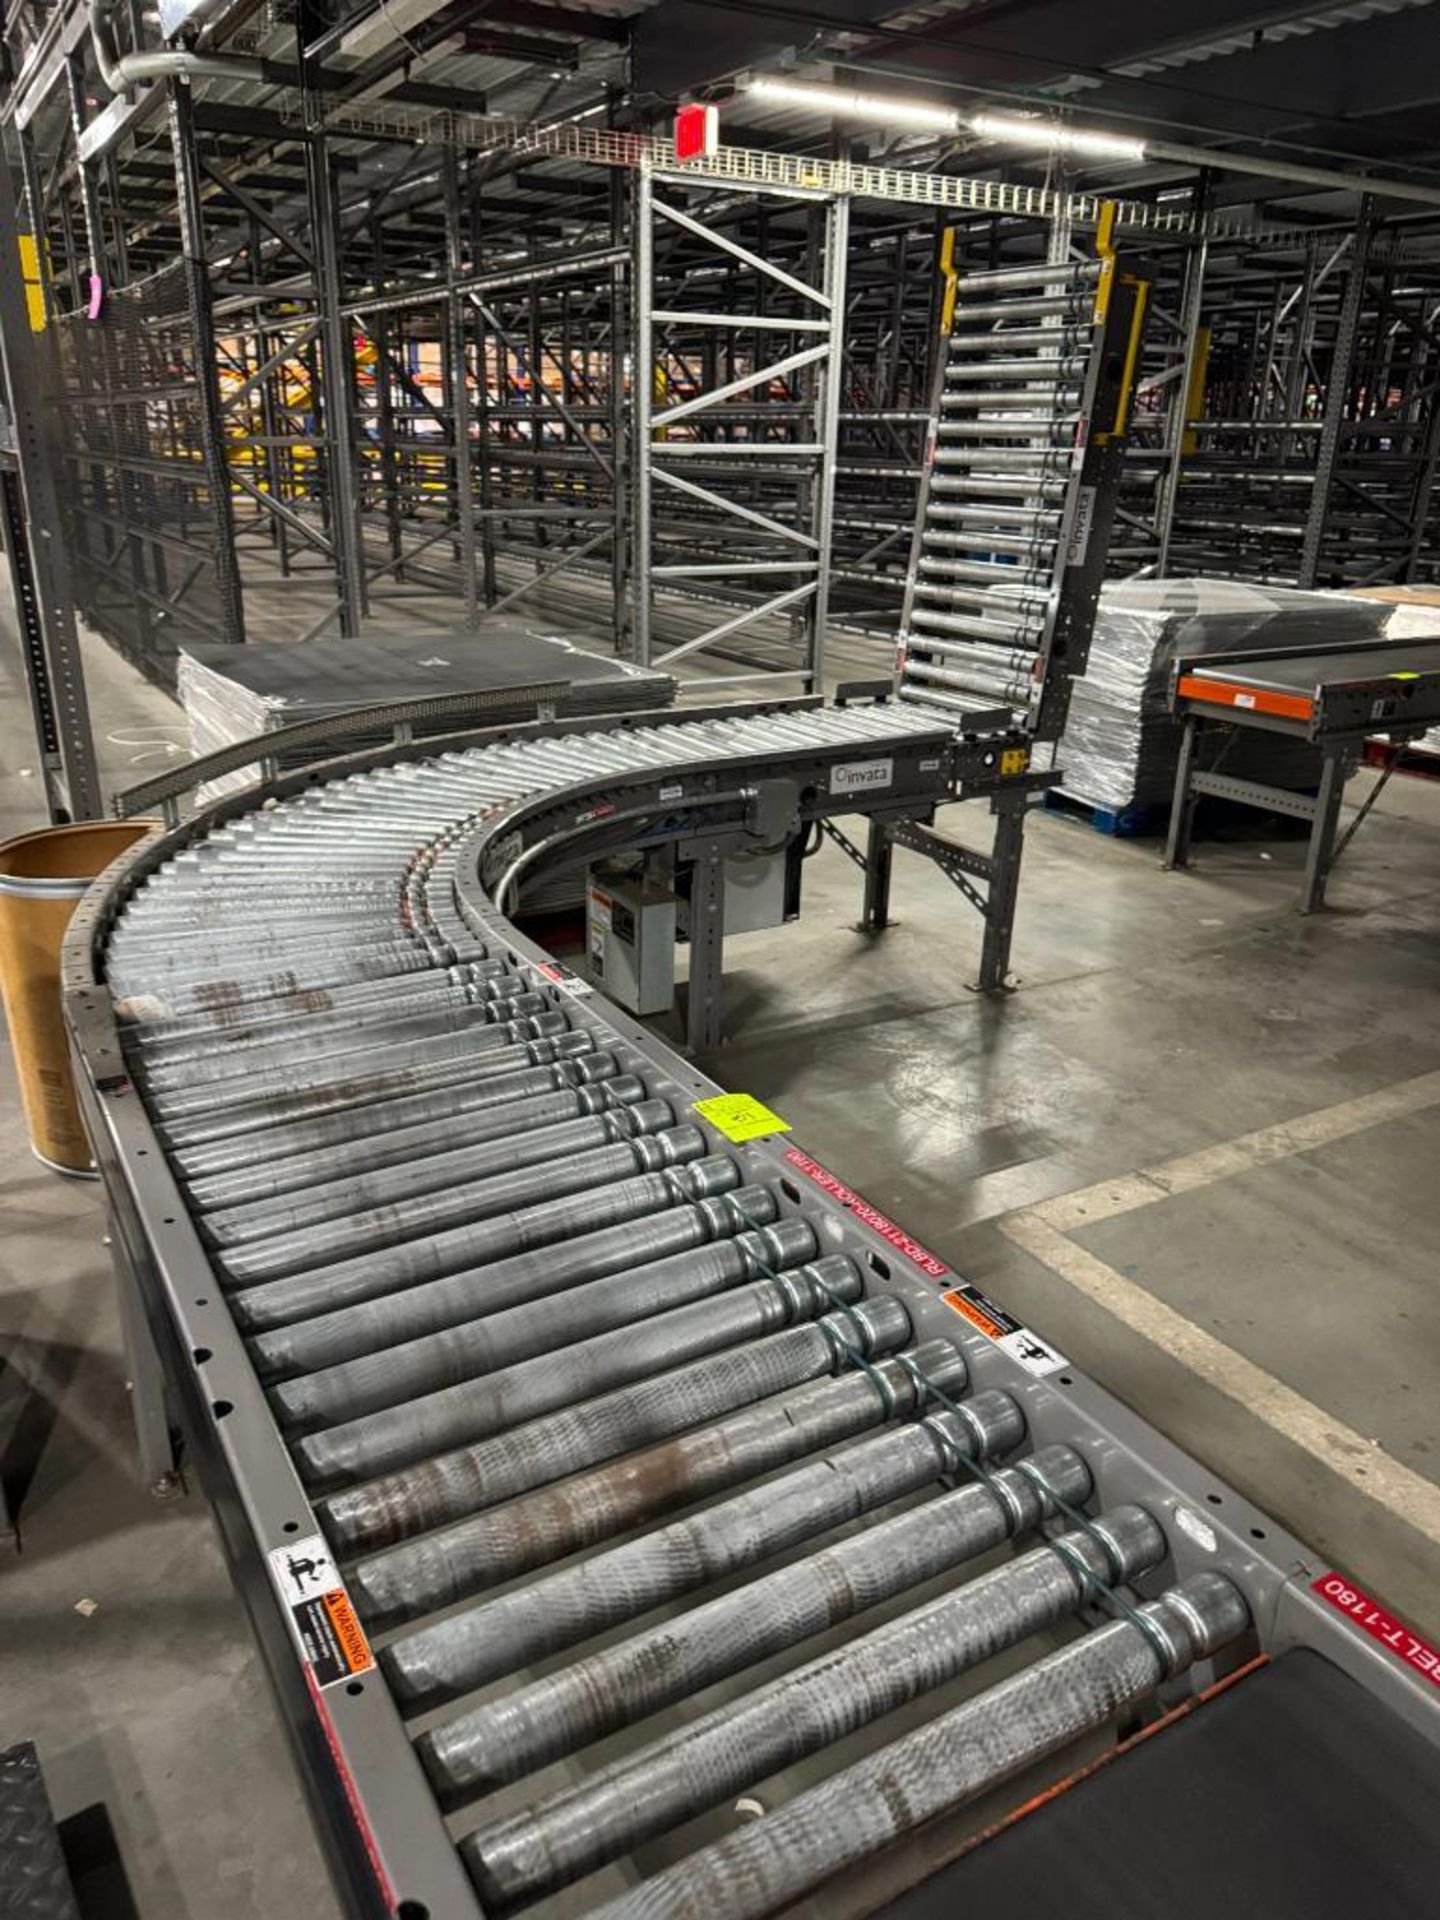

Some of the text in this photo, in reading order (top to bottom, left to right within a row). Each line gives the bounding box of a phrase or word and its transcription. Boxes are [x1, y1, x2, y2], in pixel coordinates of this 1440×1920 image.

[847, 766, 888, 785] invata
[334, 1605, 367, 1665] WARNING
[1323, 1579, 1440, 1682] BELT-1180
